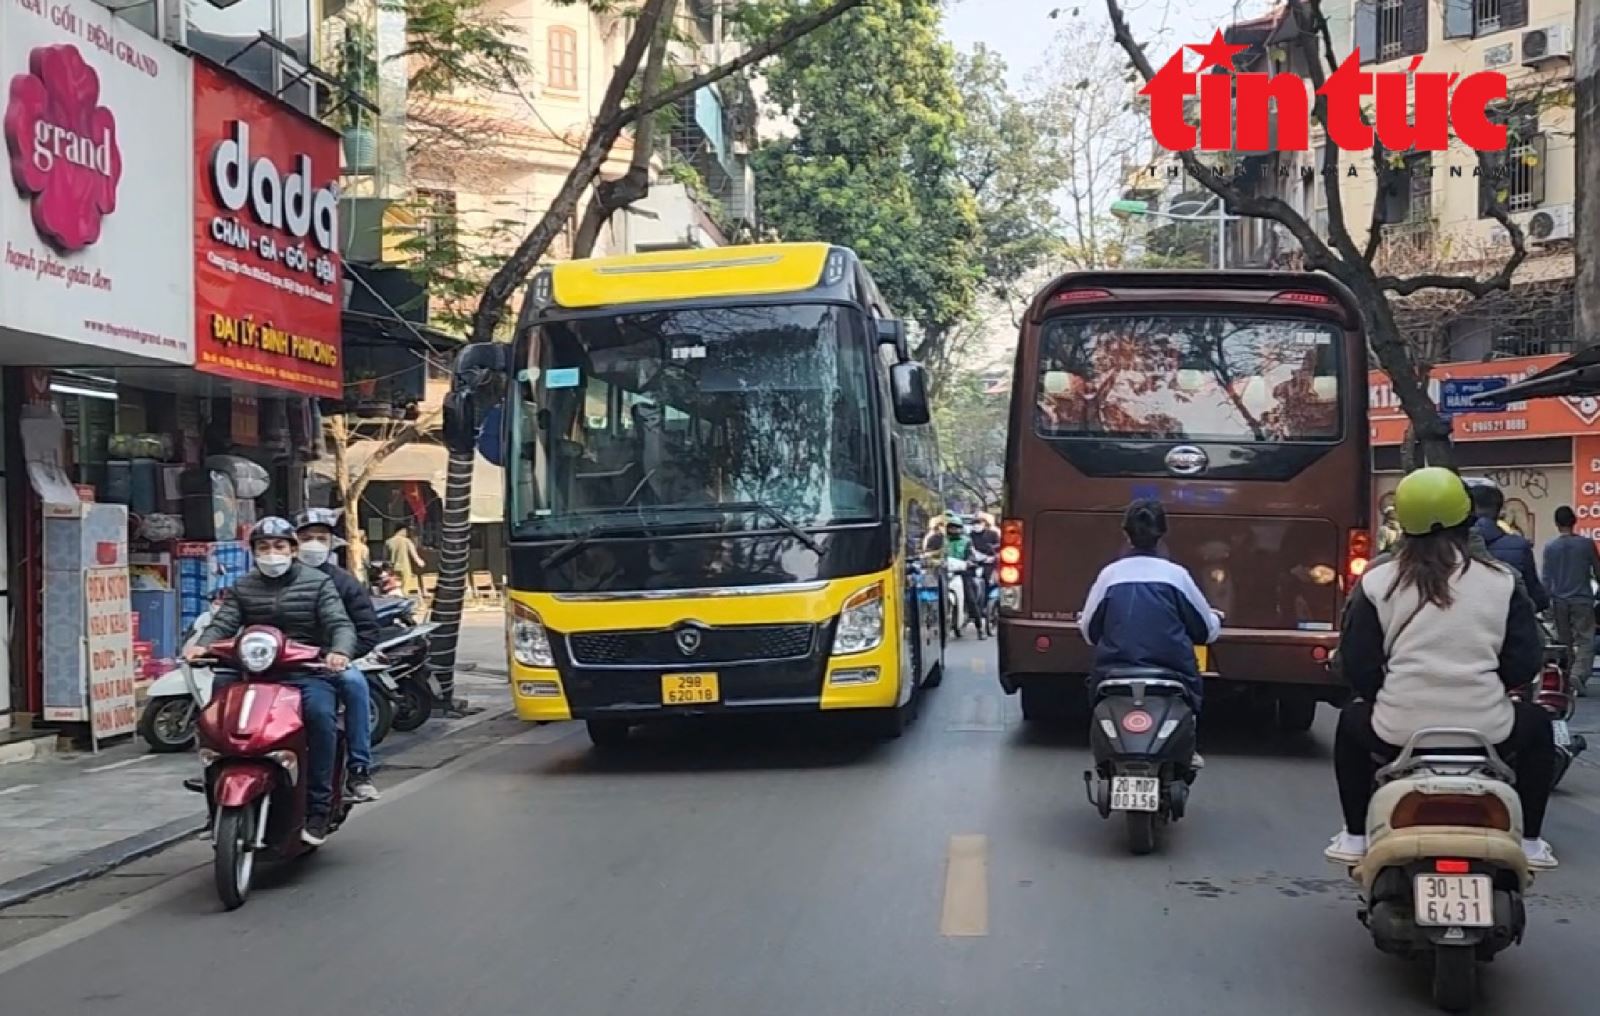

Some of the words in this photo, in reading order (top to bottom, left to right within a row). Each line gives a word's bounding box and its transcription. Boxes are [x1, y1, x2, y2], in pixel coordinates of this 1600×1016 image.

[51, 4, 76, 33] GỐI
[116, 41, 159, 78] GRAND
[34, 120, 111, 177] grand
[214, 119, 339, 253] dada
[259, 235, 278, 262] GA
[213, 313, 239, 348] ĐẠI
[677, 676, 702, 689] 29B
[1426, 877, 1479, 900] 30-L1
[1427, 901, 1480, 922] 6431
